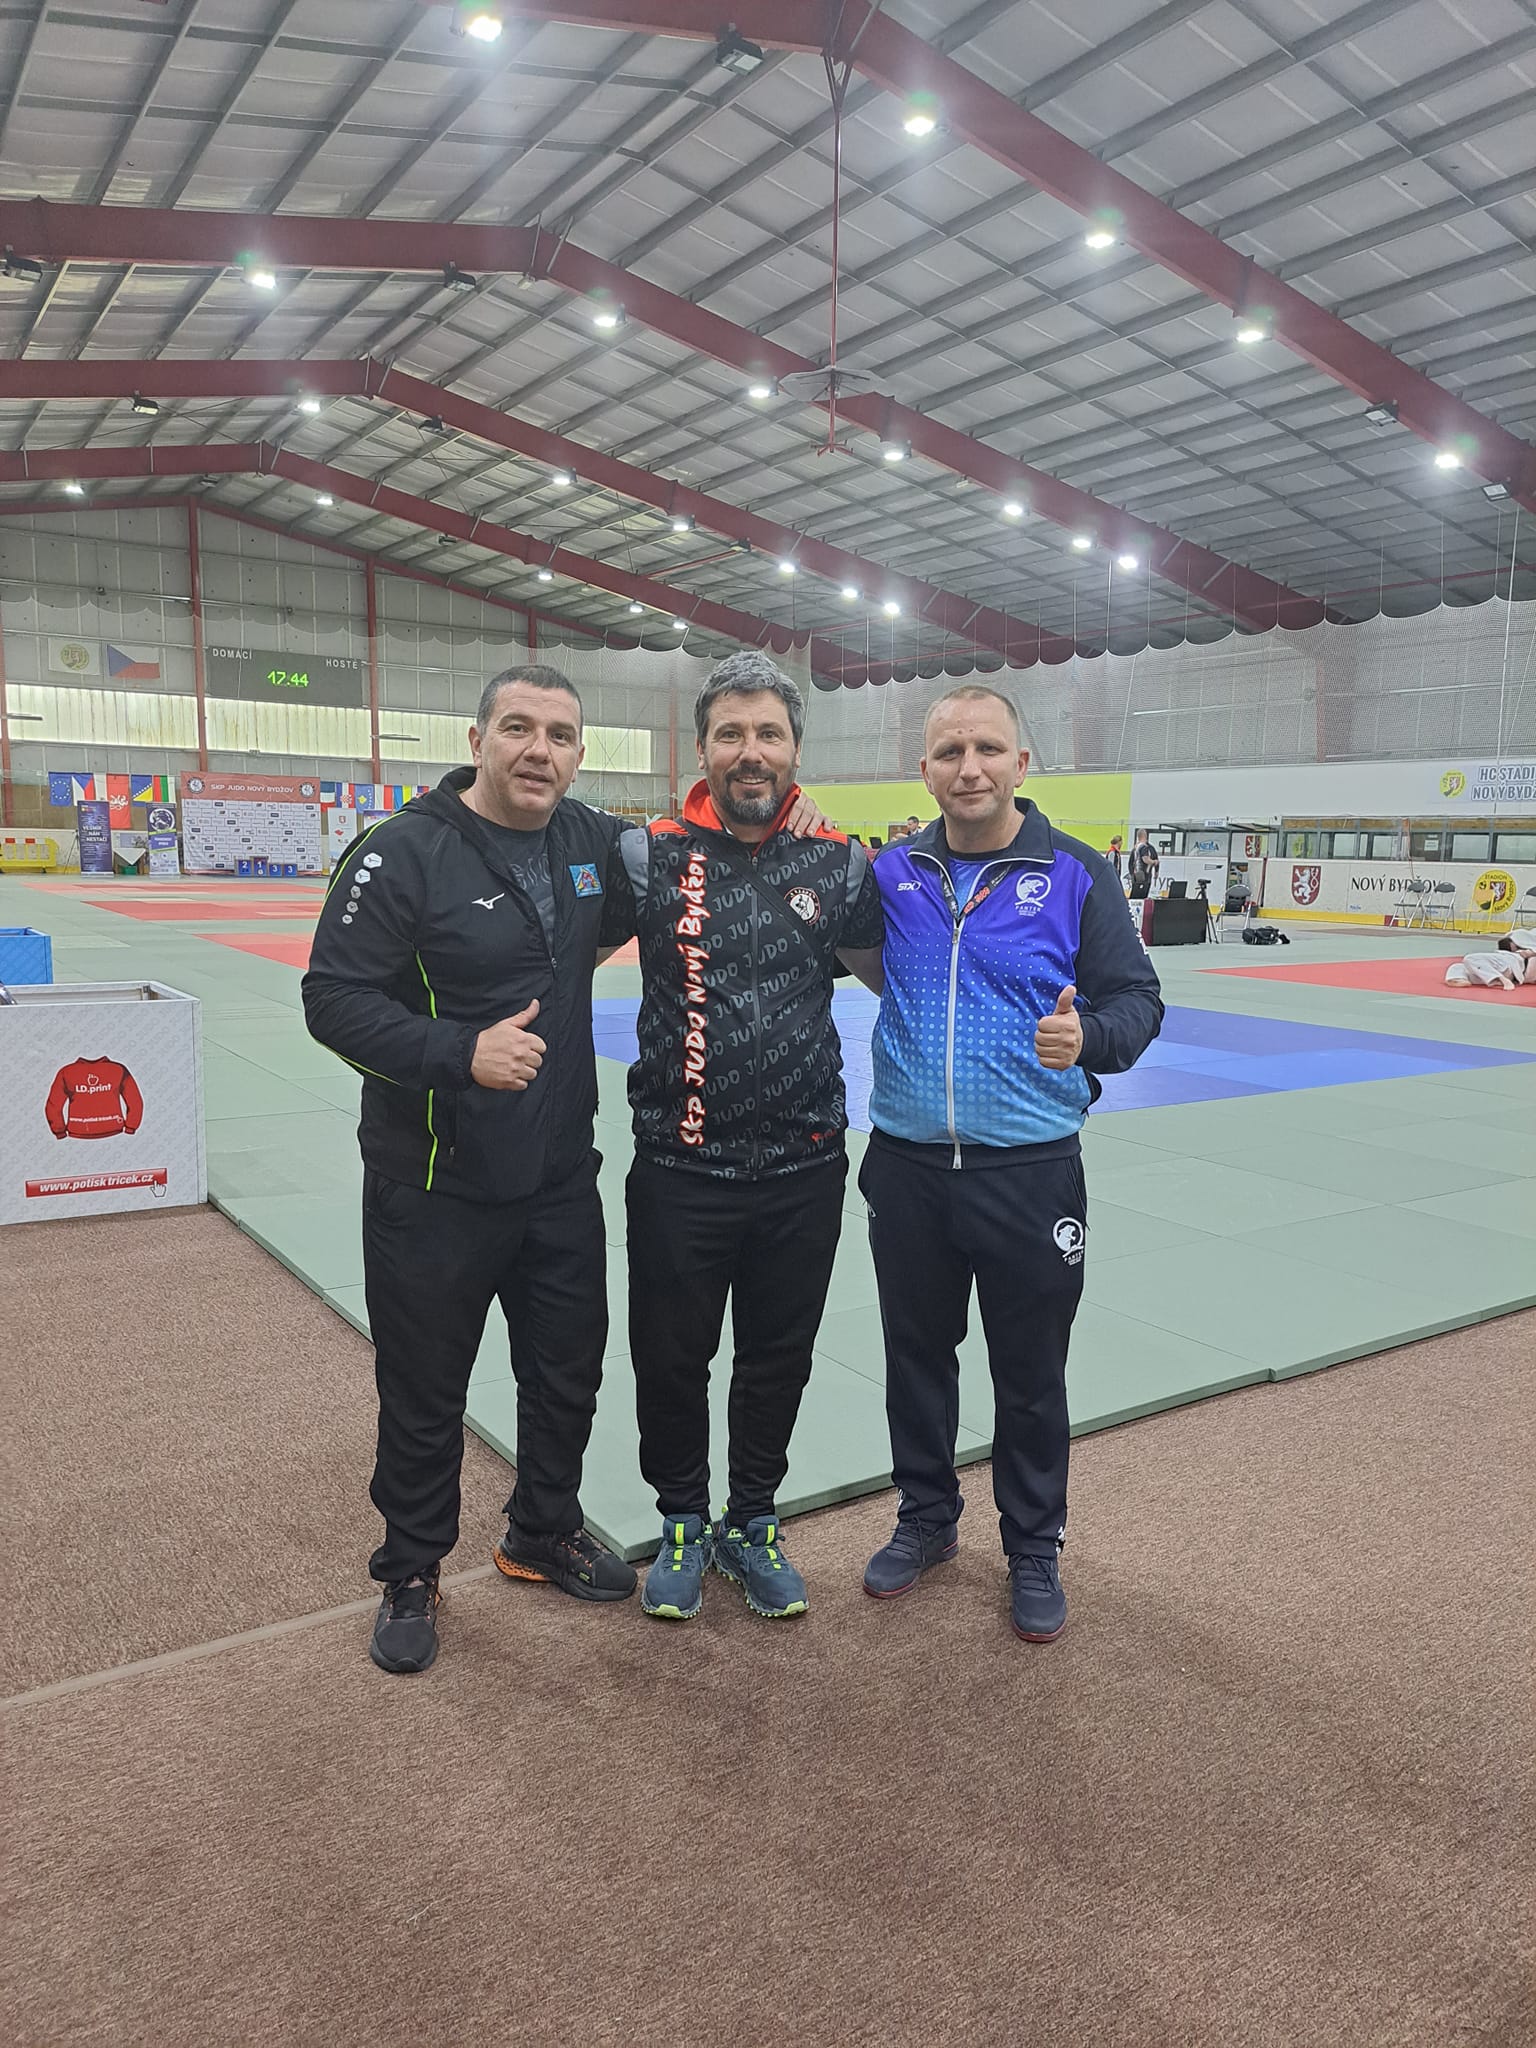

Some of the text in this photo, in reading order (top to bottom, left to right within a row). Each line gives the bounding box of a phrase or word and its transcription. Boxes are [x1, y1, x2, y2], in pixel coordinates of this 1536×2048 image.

[1480, 767, 1497, 780] HC
[1473, 782, 1506, 800] NOVÝ
[799, 841, 835, 868] JUDO
[288, 865, 293, 873] 3
[1352, 873, 1386, 891] NOVÝ
[653, 886, 681, 911] JUD
[702, 962, 738, 988] UDO
[714, 990, 753, 1018] JUDO
[760, 966, 799, 996] JUDO
[684, 1010, 707, 1087] JUDO
[762, 1067, 802, 1102] JUDO
